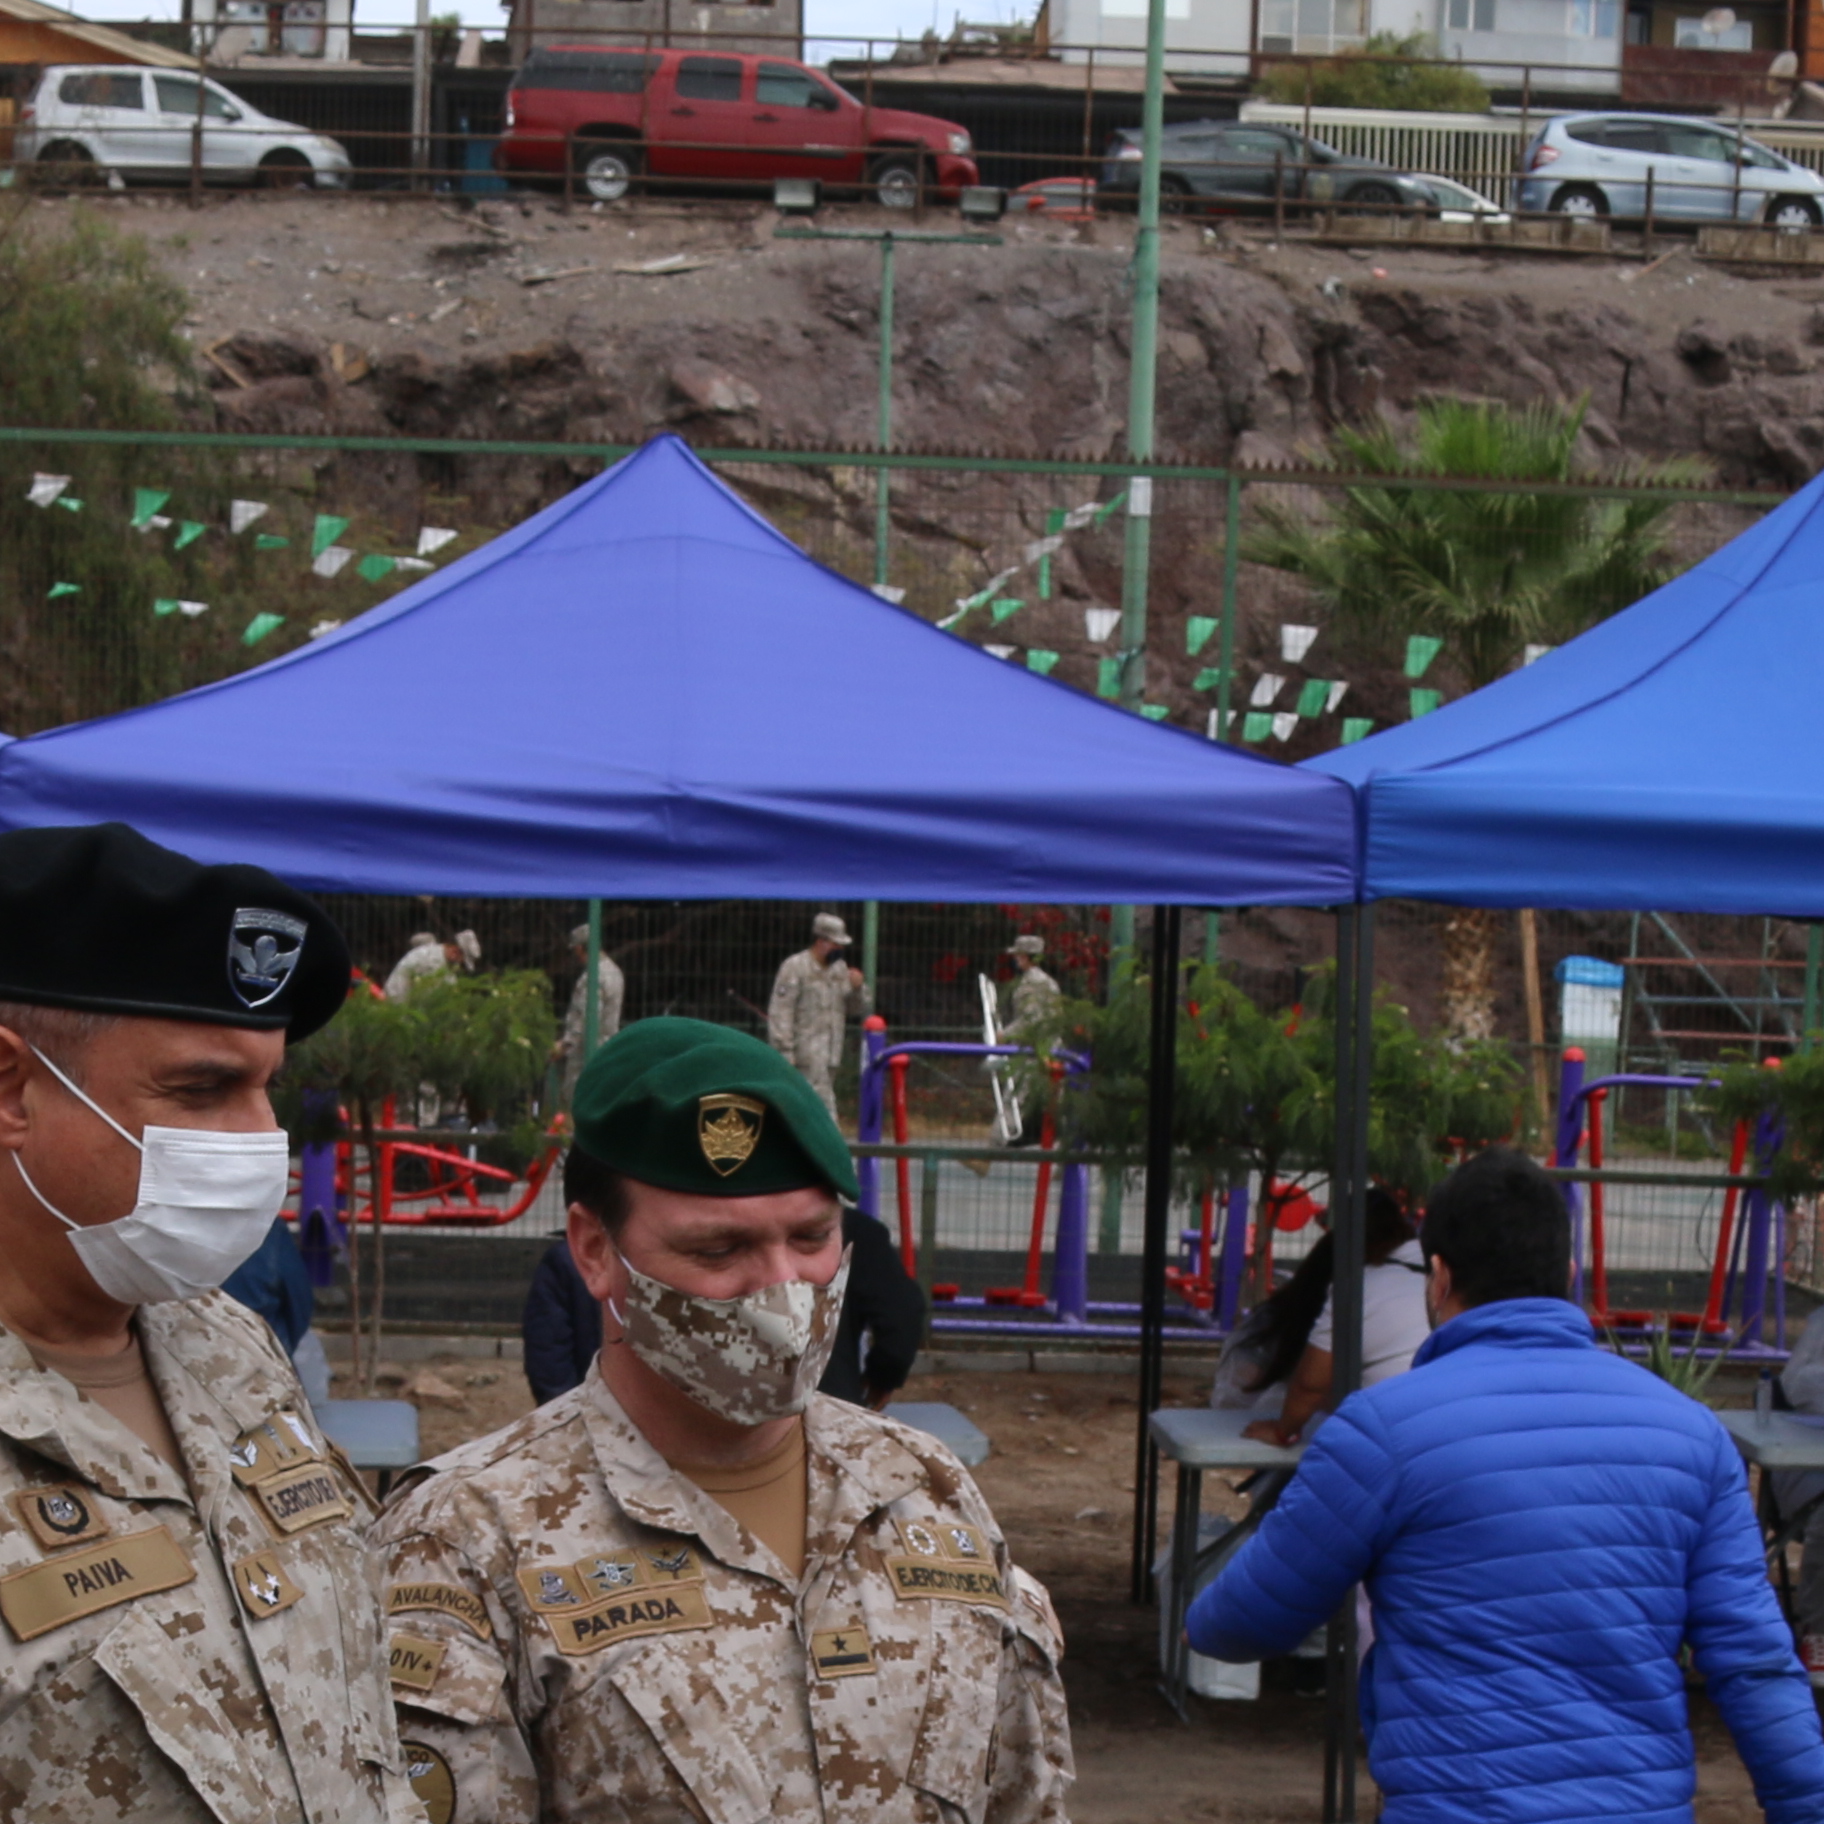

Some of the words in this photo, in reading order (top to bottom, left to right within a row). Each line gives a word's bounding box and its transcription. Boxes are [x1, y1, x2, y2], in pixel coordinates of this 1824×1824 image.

[62, 1557, 135, 1598] PAIVA
[393, 1589, 490, 1626] AVALANCHA
[572, 1597, 685, 1642] PARADA
